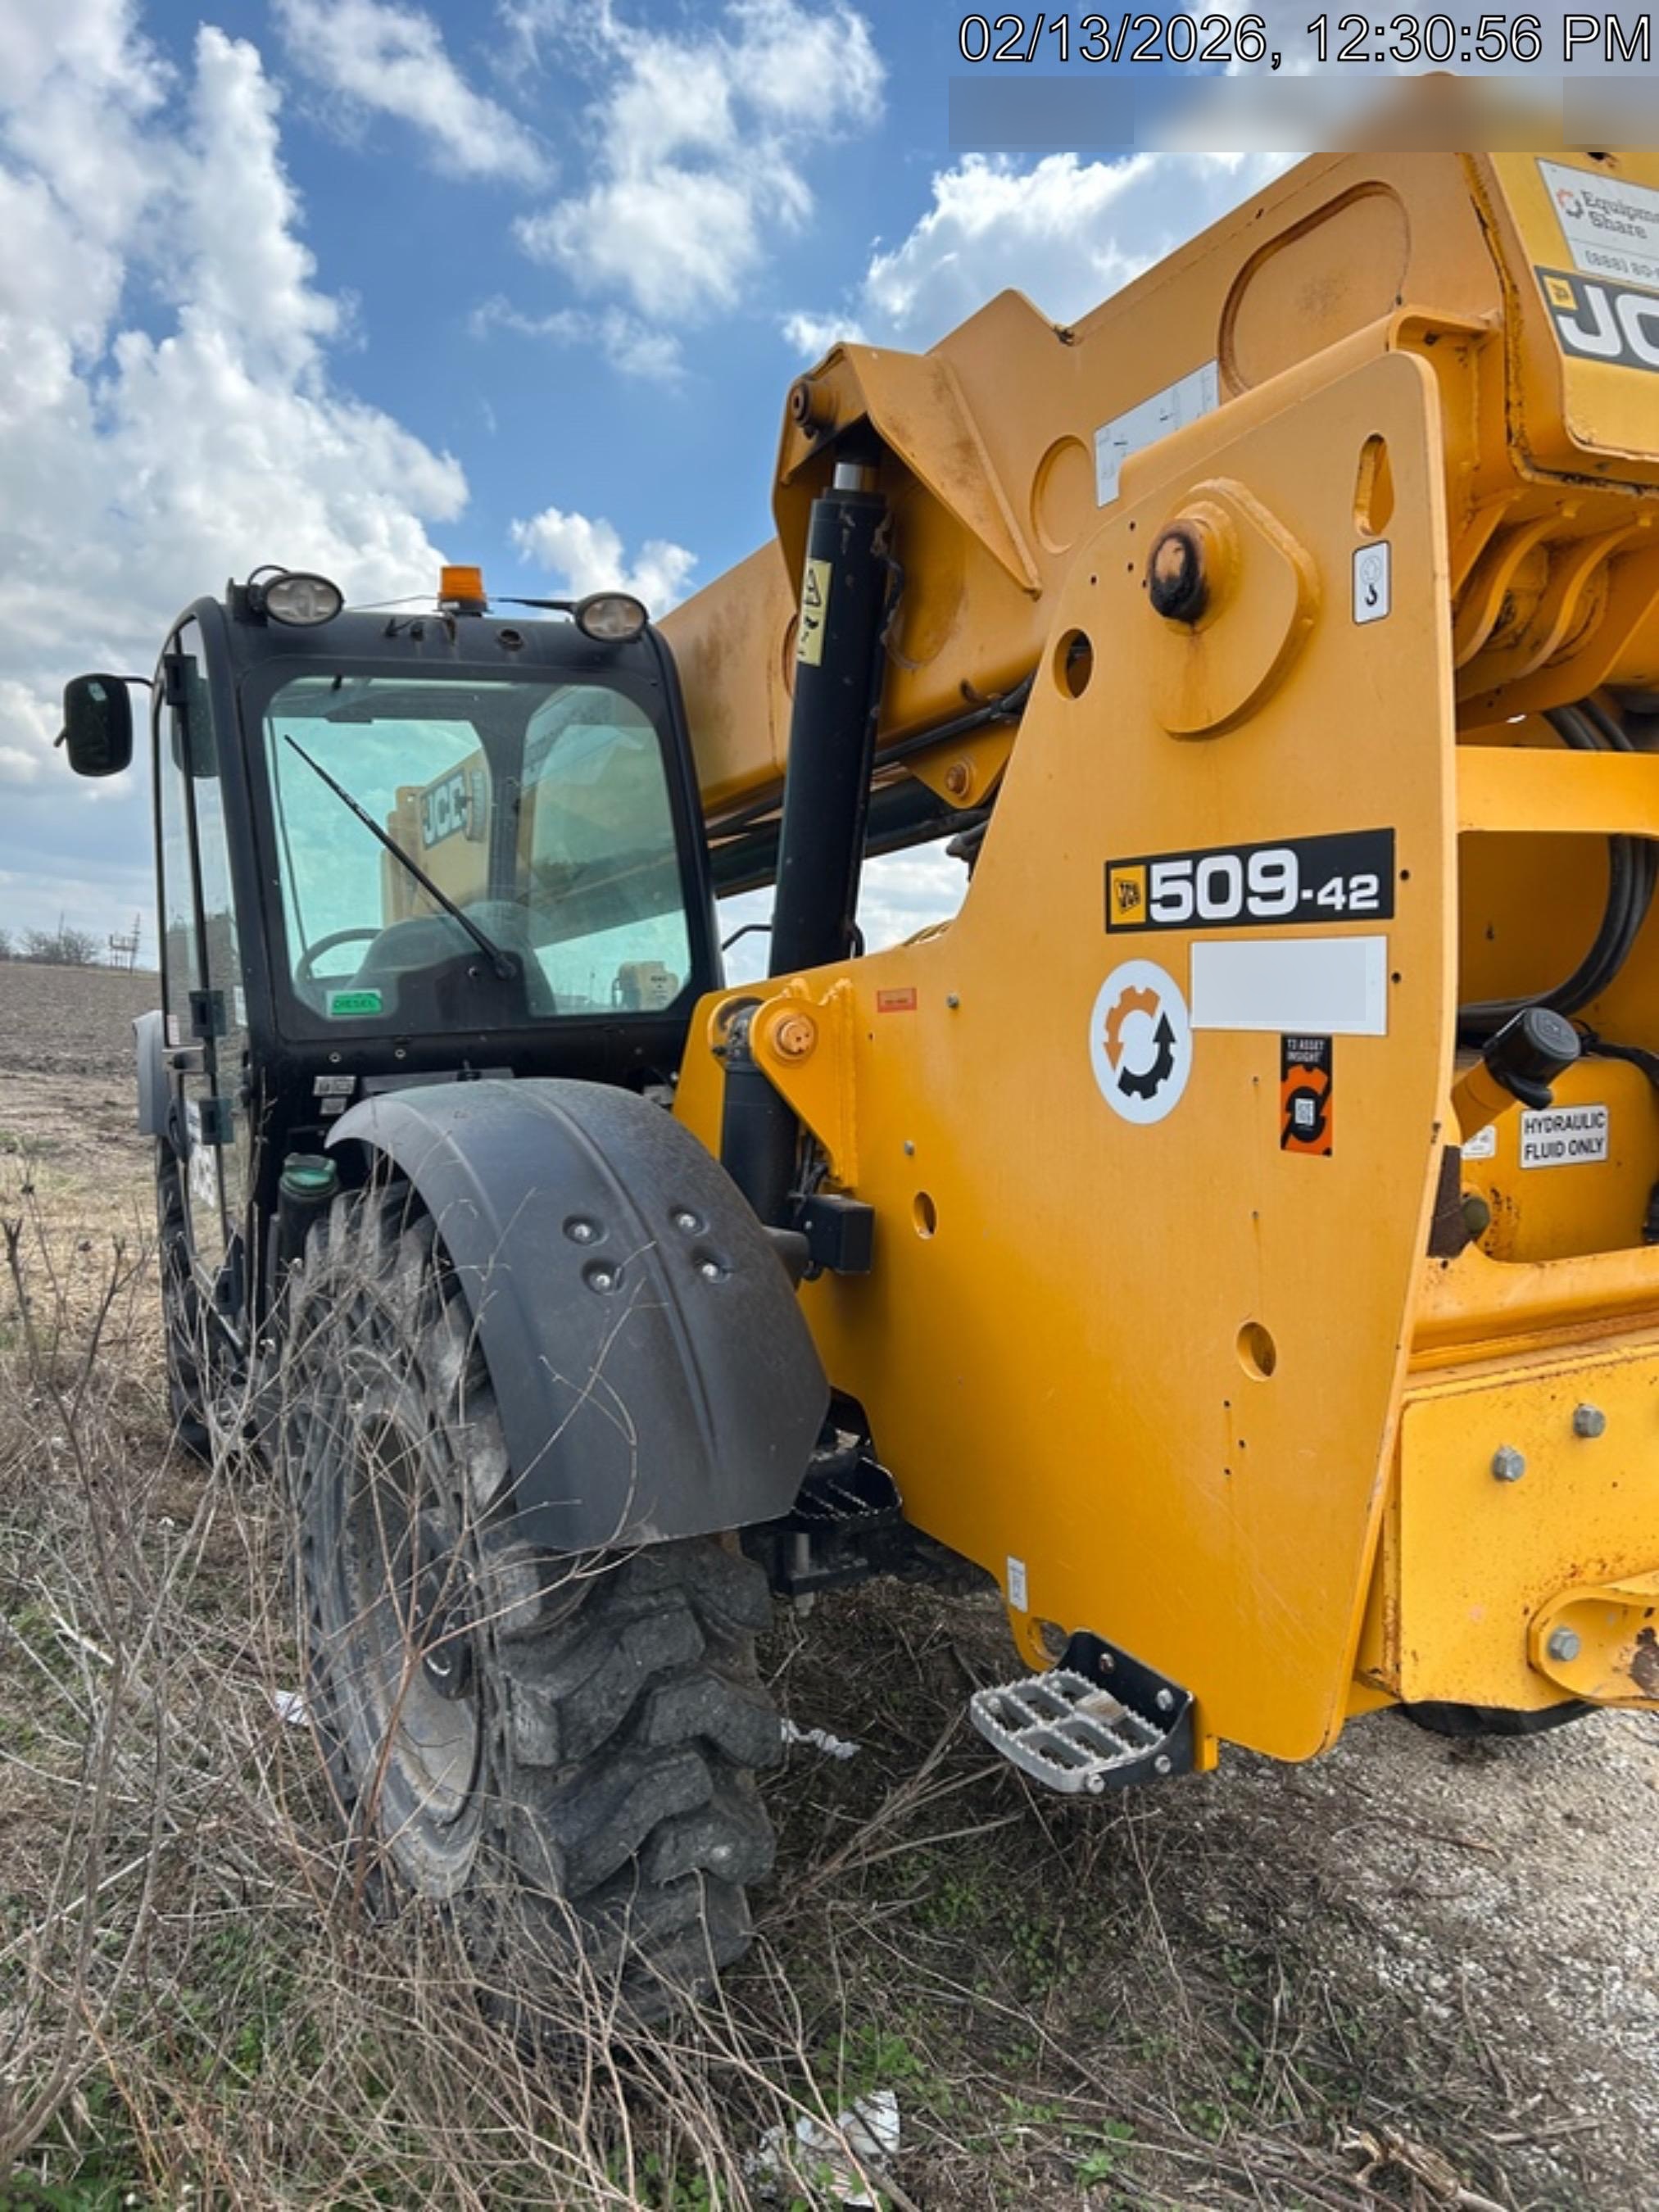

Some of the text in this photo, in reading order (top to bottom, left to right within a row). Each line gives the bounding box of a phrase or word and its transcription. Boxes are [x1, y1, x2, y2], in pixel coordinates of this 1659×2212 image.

[1588, 211, 1648, 239] Share
[1149, 848, 1379, 922] 509-42
[1524, 1112, 1606, 1134] HYDRAULIC
[1524, 1137, 1604, 1160] FLUID ONLY
